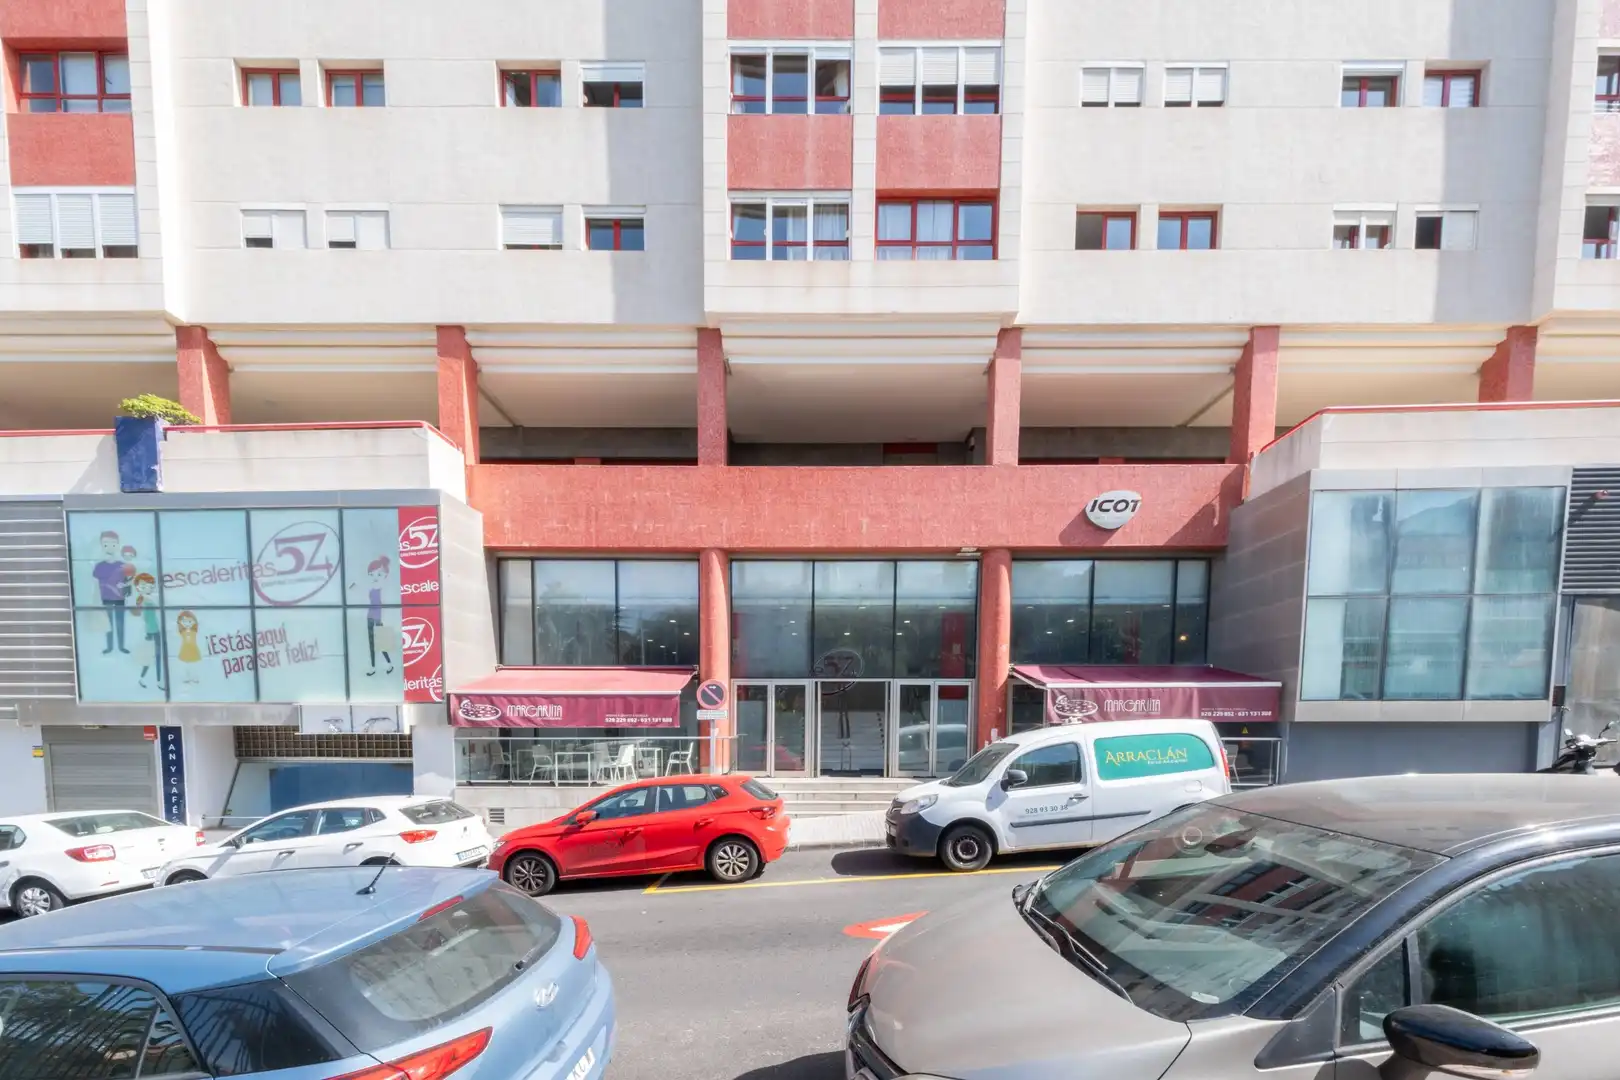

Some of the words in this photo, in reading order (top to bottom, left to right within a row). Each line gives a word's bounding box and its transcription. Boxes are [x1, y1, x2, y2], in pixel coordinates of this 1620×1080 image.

[161, 560, 277, 588] escaleritas
[205, 630, 254, 655] ¡Estás
[222, 654, 256, 678] para
[257, 650, 281, 669] ser
[167, 733, 176, 760] PAN
[1105, 745, 1188, 766] ARRACLÁN
[169, 765, 177, 773] Y
[170, 777, 179, 814] CAFÉ
